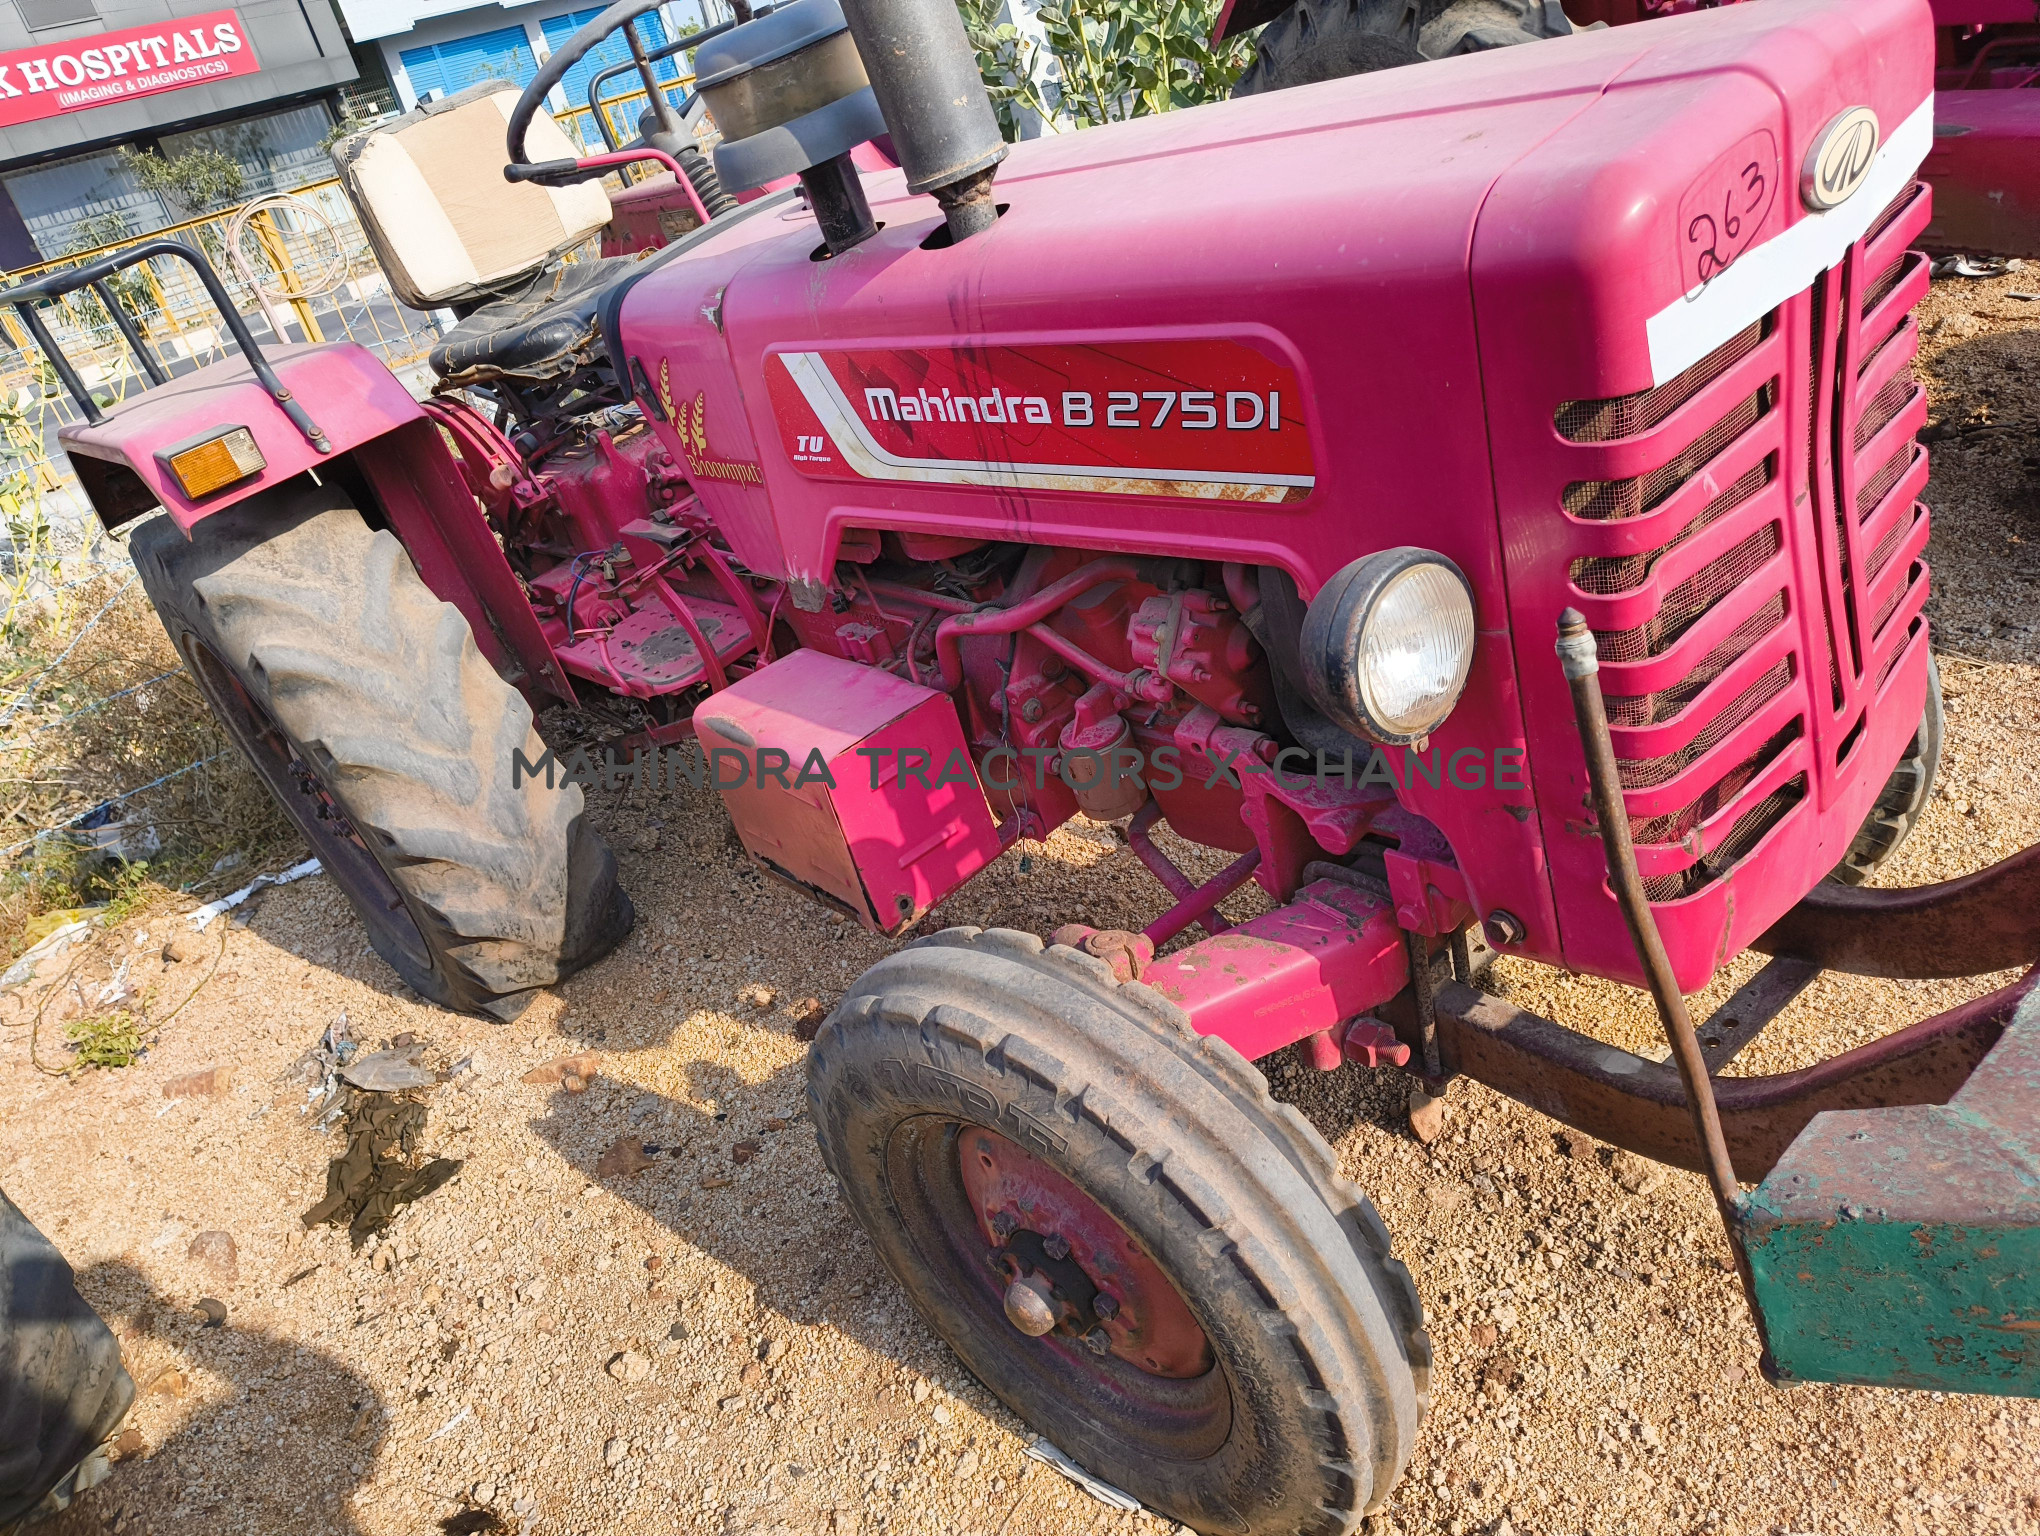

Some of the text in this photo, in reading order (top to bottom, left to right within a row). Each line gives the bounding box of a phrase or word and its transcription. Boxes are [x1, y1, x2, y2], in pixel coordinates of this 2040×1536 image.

[17, 23, 241, 94] HOSPITALS
[59, 59, 229, 107] (IMAGING & DIAGNOSTICS)
[1688, 161, 1765, 281] 263
[863, 387, 1053, 424] Mahindra
[1061, 391, 1094, 427] B
[796, 435, 824, 453] TU
[881, 1057, 1070, 1156] MRF
